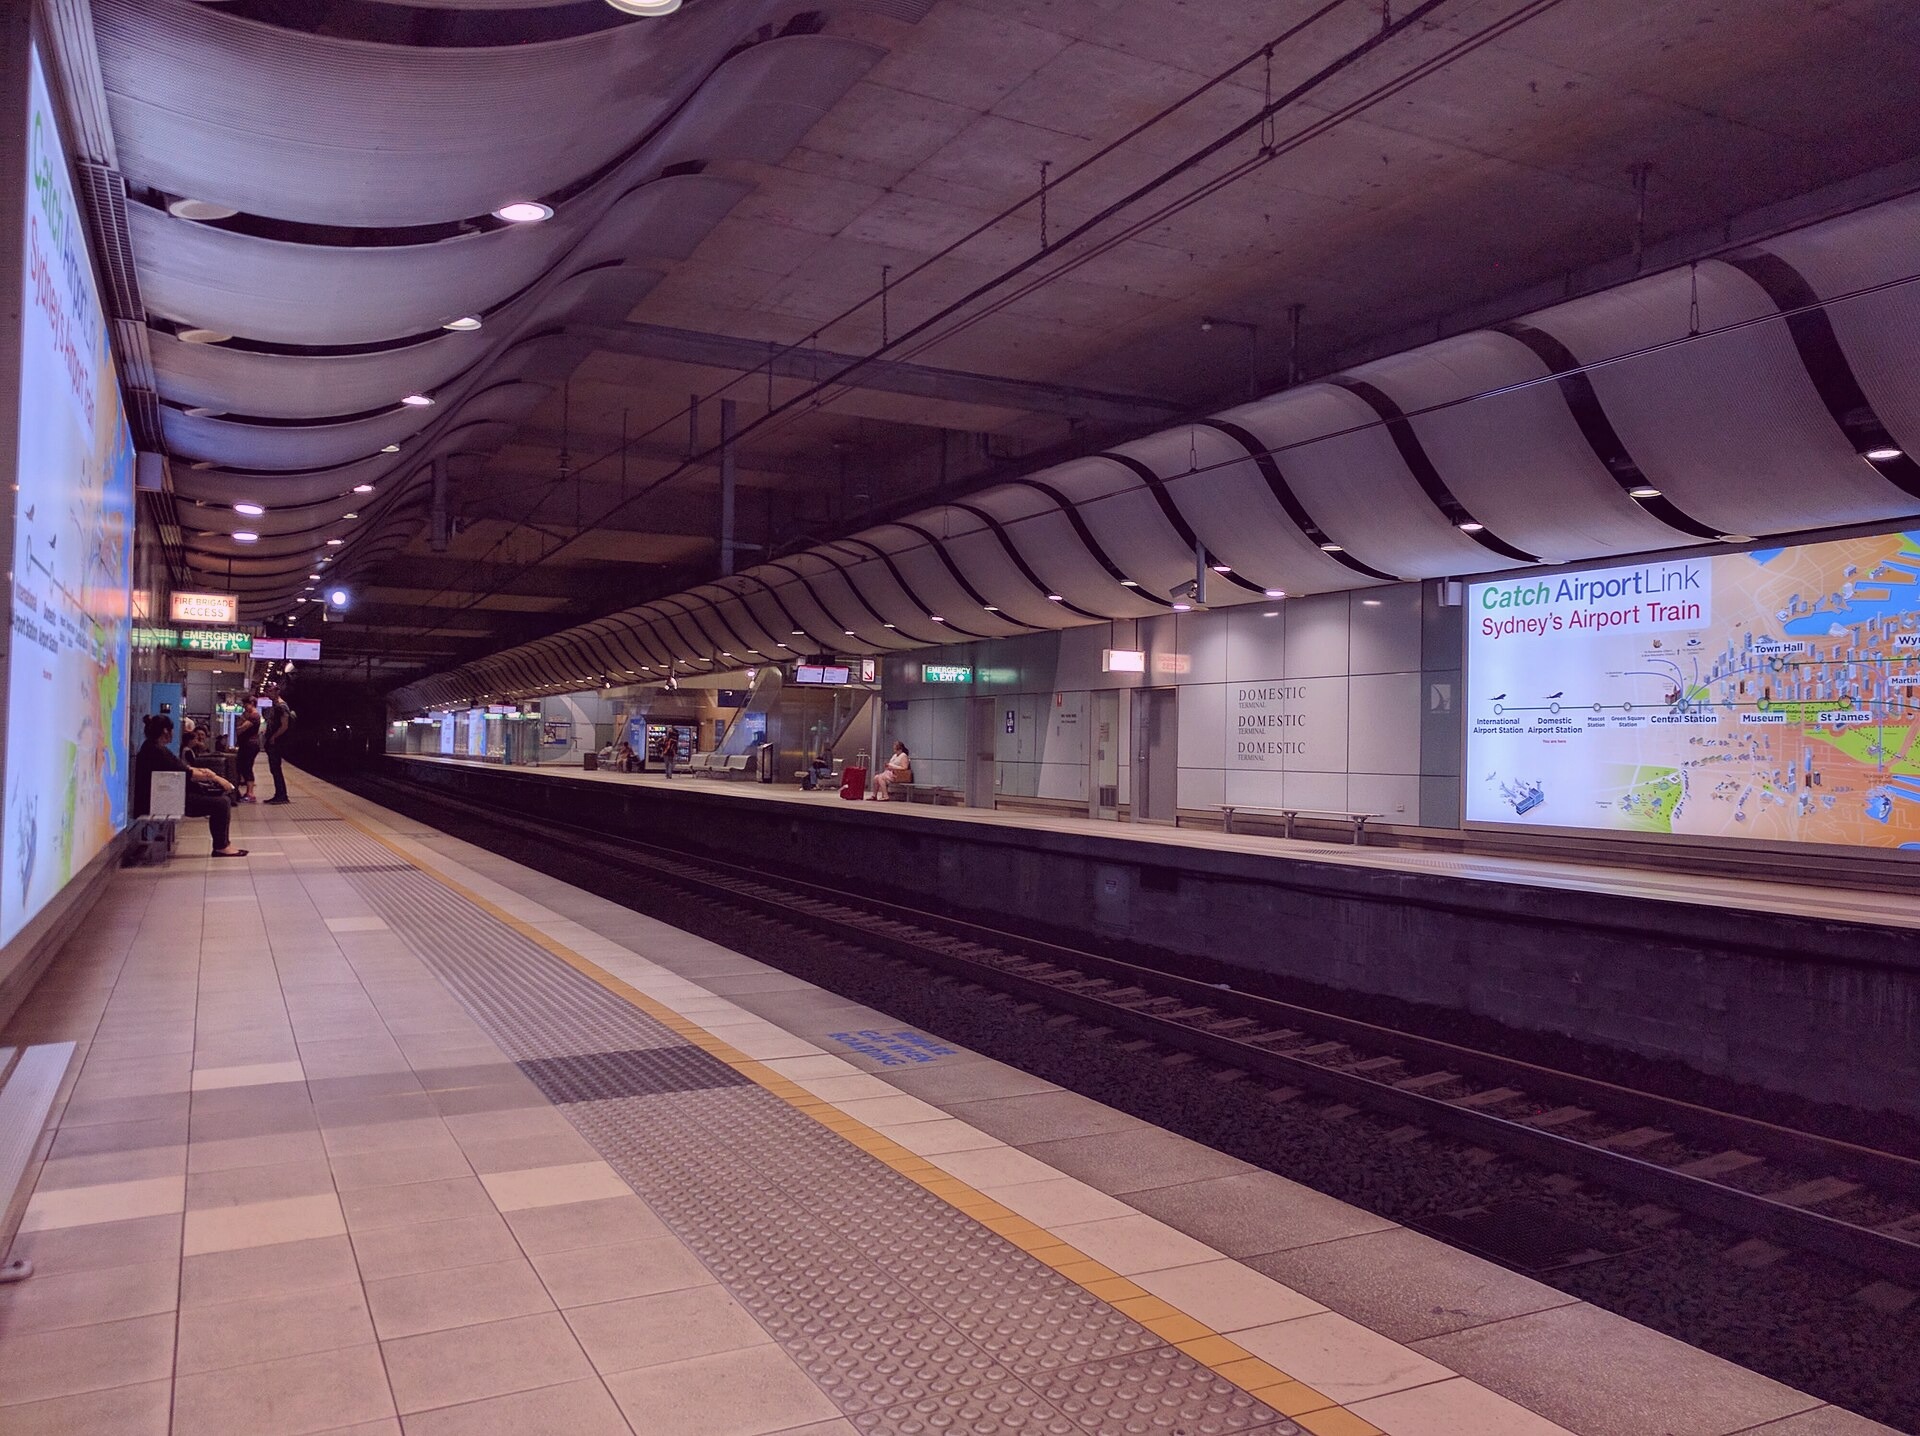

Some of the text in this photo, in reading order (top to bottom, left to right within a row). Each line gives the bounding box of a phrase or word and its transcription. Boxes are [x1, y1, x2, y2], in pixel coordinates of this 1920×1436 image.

[33, 109, 64, 254] Catch
[30, 214, 65, 354] Sydney's
[64, 315, 86, 406] Airport
[1482, 564, 1701, 610] Catch AirportLink
[174, 596, 234, 608] FIRE BRIGADE
[183, 607, 224, 618] ACCESS
[1482, 600, 1701, 640] Sydney's Airport Train
[182, 630, 251, 642] EMERGENCY
[201, 639, 227, 650] EXIT
[1755, 643, 1803, 653] Town Hall
[927, 665, 971, 674] EMERGENCY
[940, 673, 958, 682] EXIT
[1891, 676, 1918, 684] Martin
[1239, 686, 1307, 701] DOMESTIC
[1238, 714, 1306, 727] DOMESTIC
[1476, 717, 1520, 725] International
[1537, 717, 1572, 725] Domestic
[1650, 714, 1717, 724] Central Station
[1742, 714, 1784, 722] Museum
[1820, 713, 1870, 721] St James
[1473, 725, 1524, 735] Airport Station
[1528, 725, 1583, 735] Airport Station
[1238, 741, 1306, 754] DOMESTIC
[827, 1032, 907, 1066] BOARDING
[857, 1030, 937, 1063] GAP WHEN
